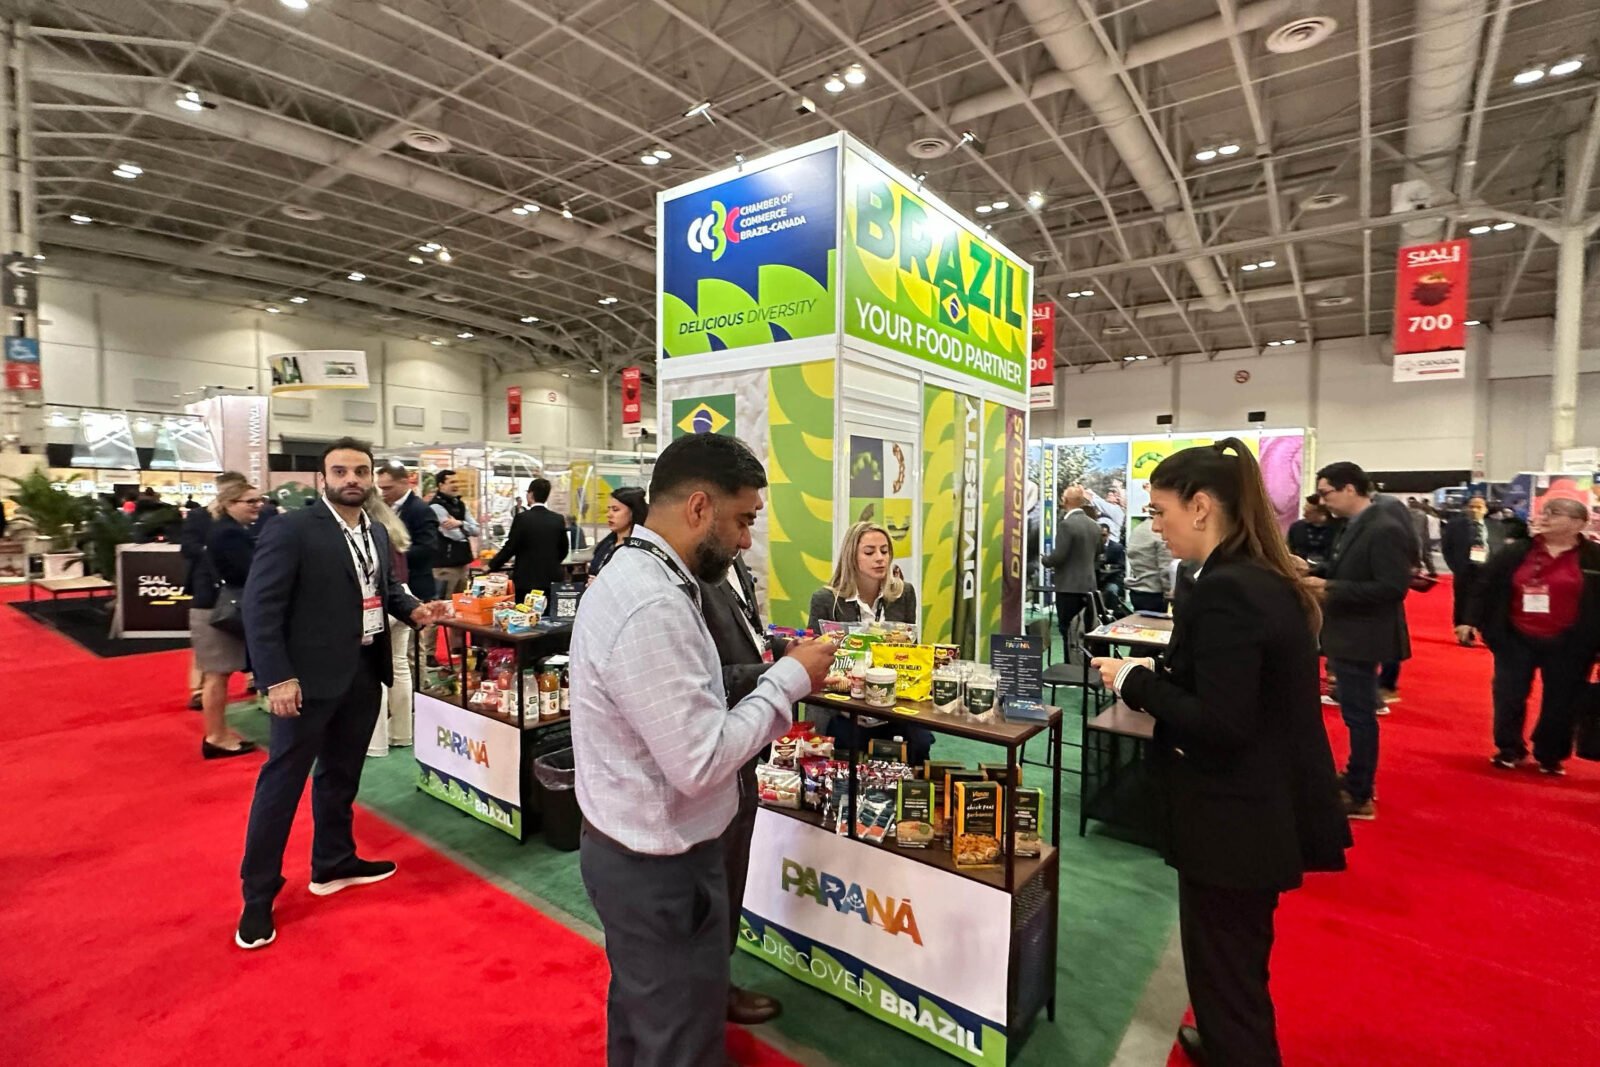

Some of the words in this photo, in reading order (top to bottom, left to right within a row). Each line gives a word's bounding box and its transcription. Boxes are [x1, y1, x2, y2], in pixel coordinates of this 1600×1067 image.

[740, 197, 780, 215] CHAMBER
[780, 193, 793, 204] OF
[740, 208, 787, 228] COMMERCE
[740, 215, 807, 240] BRAZIL-CANADA
[856, 178, 1022, 331] BRAZIL
[679, 312, 744, 335] DELICIOUS
[746, 299, 816, 323] DIVERSITY
[1408, 314, 1453, 332] 700
[856, 297, 912, 346] YOUR
[916, 324, 963, 363] FOOD
[965, 347, 1022, 385] PARTNER
[248, 404, 261, 448] TAIWAN
[963, 396, 978, 600] DIVERSITY
[1010, 414, 1024, 579] DELICIOUS
[138, 576, 171, 586] SIAL
[437, 726, 490, 768] PARANÁ
[474, 799, 514, 828] BRAZIL
[782, 857, 924, 947] PARANÁ
[763, 934, 873, 1003] DISCOVER
[880, 989, 984, 1057] BRAZIL
